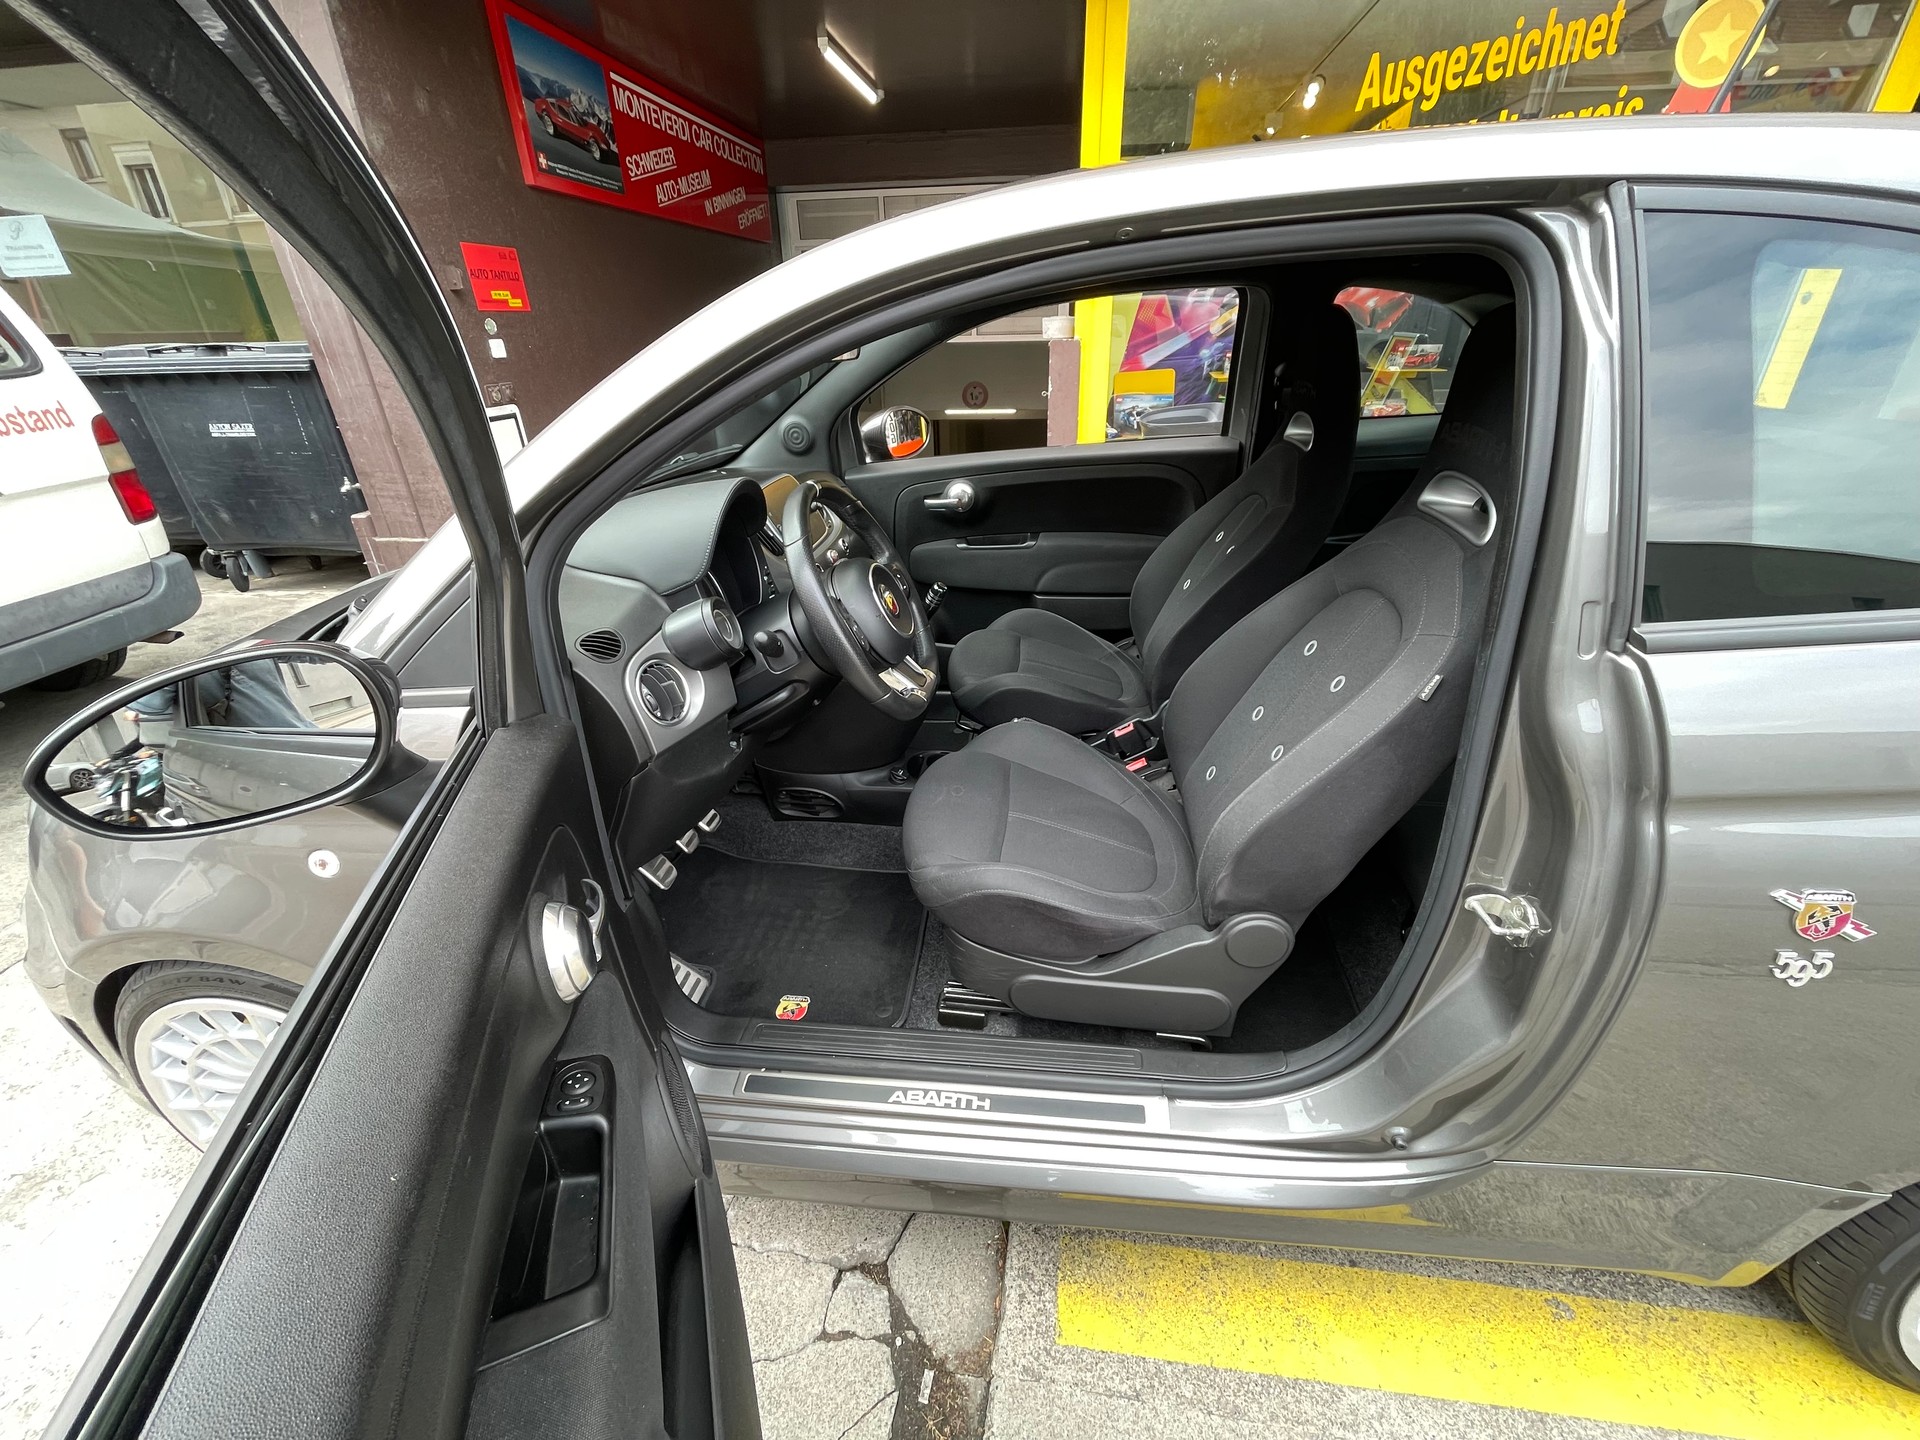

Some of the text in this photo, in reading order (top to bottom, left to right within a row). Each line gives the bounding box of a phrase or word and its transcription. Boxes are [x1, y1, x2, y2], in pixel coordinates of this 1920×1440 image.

[1354, 0, 1627, 112] Ausgezeichnet
[611, 84, 764, 176] MONTEVERDI CAR COLLECTION
[625, 146, 676, 177] SCHWEIZER
[655, 169, 711, 204] AUTO-MUSEUM
[704, 186, 746, 217] IN BINNINGEN
[469, 268, 488, 279] AUTO
[1769, 949, 1835, 987] 595
[887, 1090, 991, 1111] ABARTH
